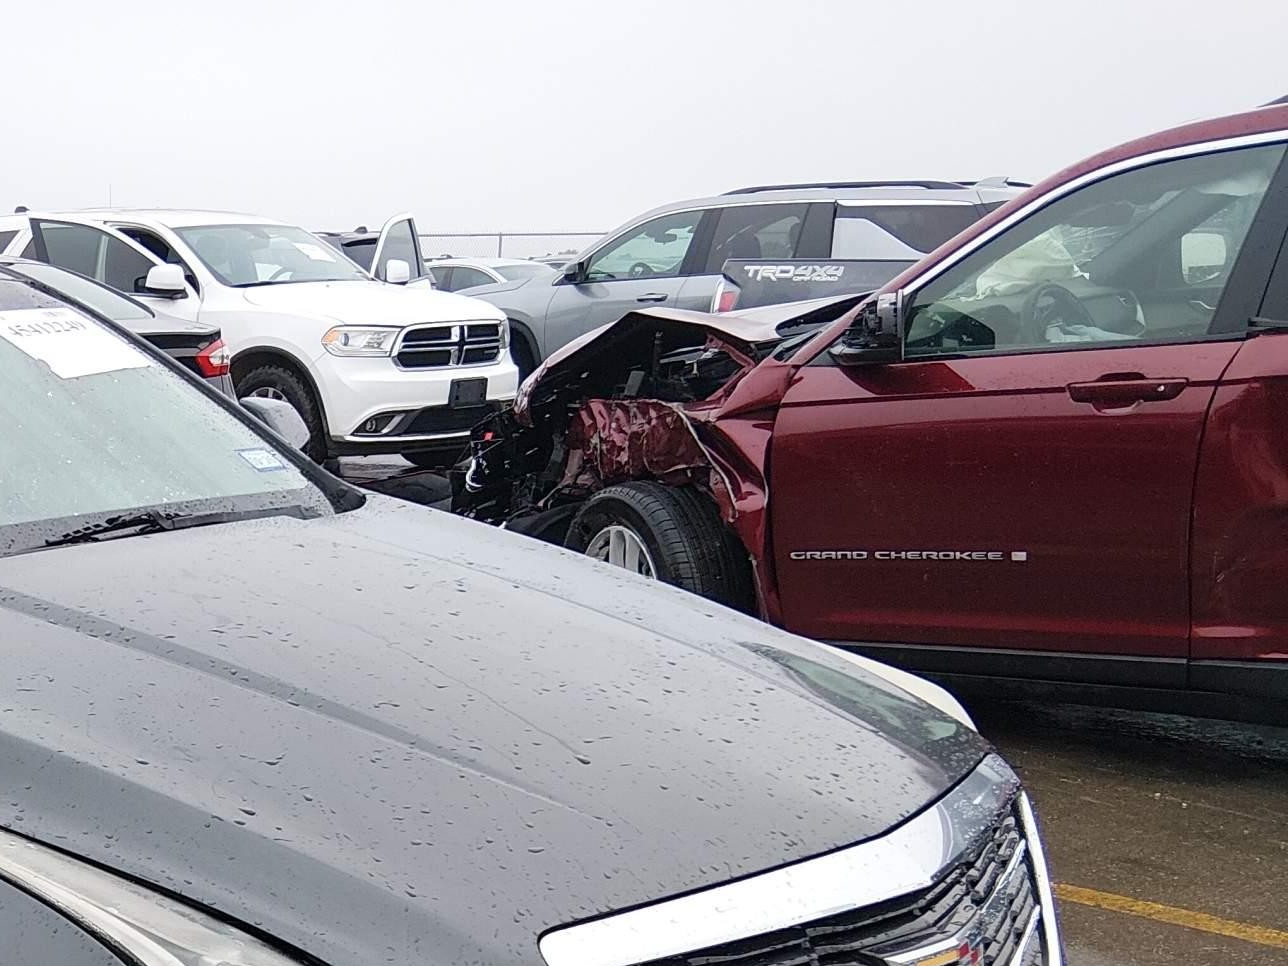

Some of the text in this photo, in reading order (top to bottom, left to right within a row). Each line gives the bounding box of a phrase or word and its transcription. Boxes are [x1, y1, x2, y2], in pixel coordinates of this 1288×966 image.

[743, 265, 794, 281] TRD
[790, 551, 1004, 561] GRAND CHEROKEE
